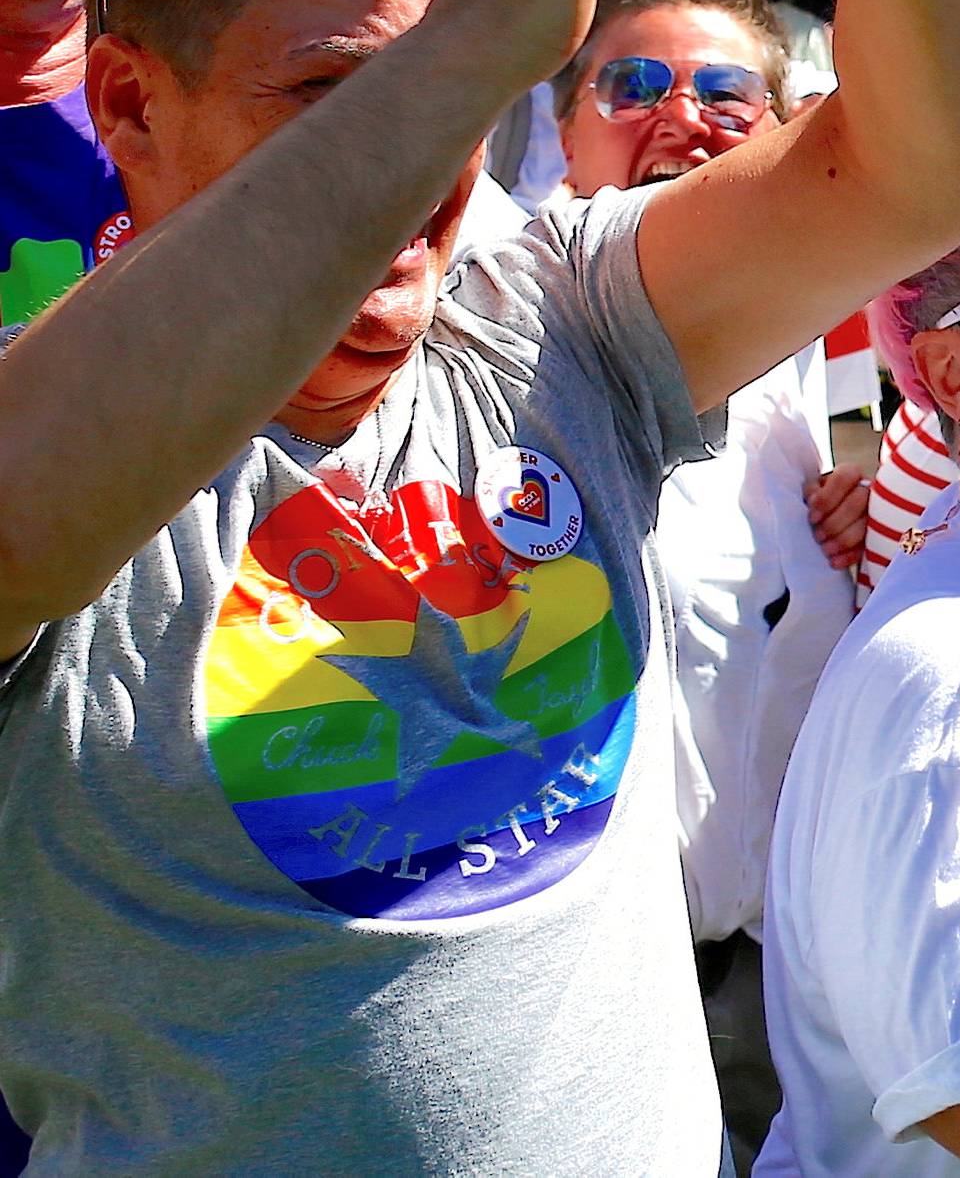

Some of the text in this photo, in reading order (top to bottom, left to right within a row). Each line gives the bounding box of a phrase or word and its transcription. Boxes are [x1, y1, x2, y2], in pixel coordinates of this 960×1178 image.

[98, 215, 132, 260] STRO
[529, 514, 580, 557] TOGETHER
[262, 712, 384, 771] Chuck
[308, 742, 602, 882] ALL STAR
